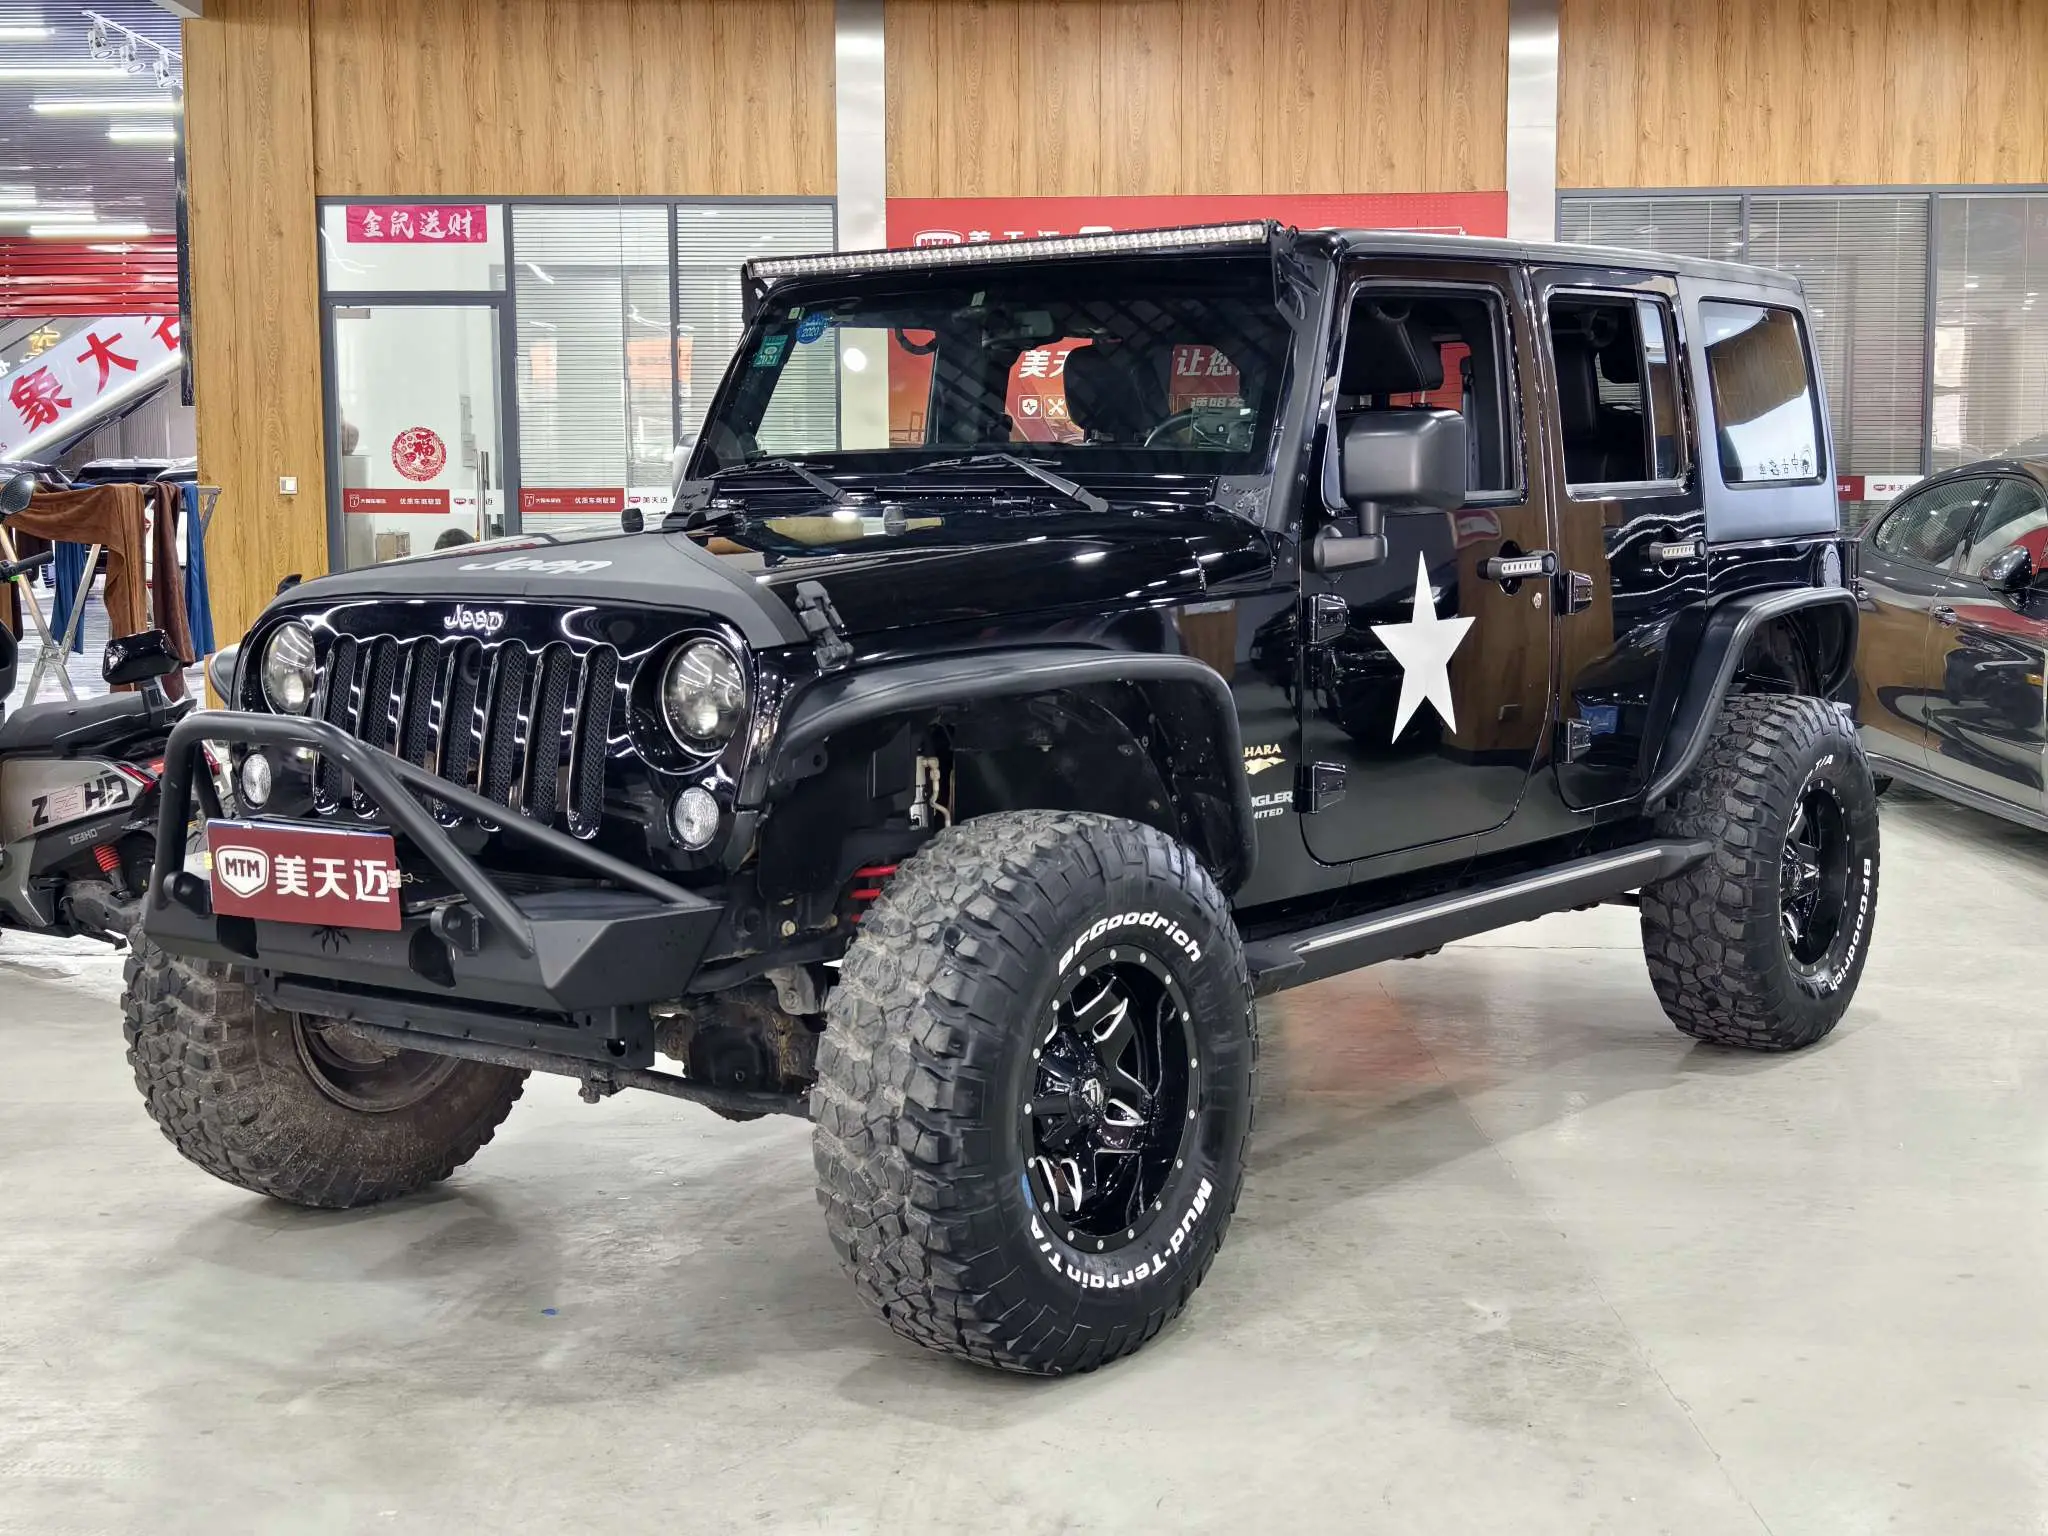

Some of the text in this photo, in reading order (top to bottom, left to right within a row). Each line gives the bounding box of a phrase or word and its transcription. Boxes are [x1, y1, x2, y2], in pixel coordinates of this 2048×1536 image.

[1177, 349, 1240, 376] 让您
[458, 556, 613, 574] Jeep
[443, 603, 504, 636] Jeep
[224, 857, 261, 879] MTM
[274, 854, 391, 903] 美天迈
[1058, 911, 1201, 976] BFGoodrich
[1829, 858, 1872, 992] BFGoodrich
[1065, 1177, 1214, 1289] Mud-Terrain
